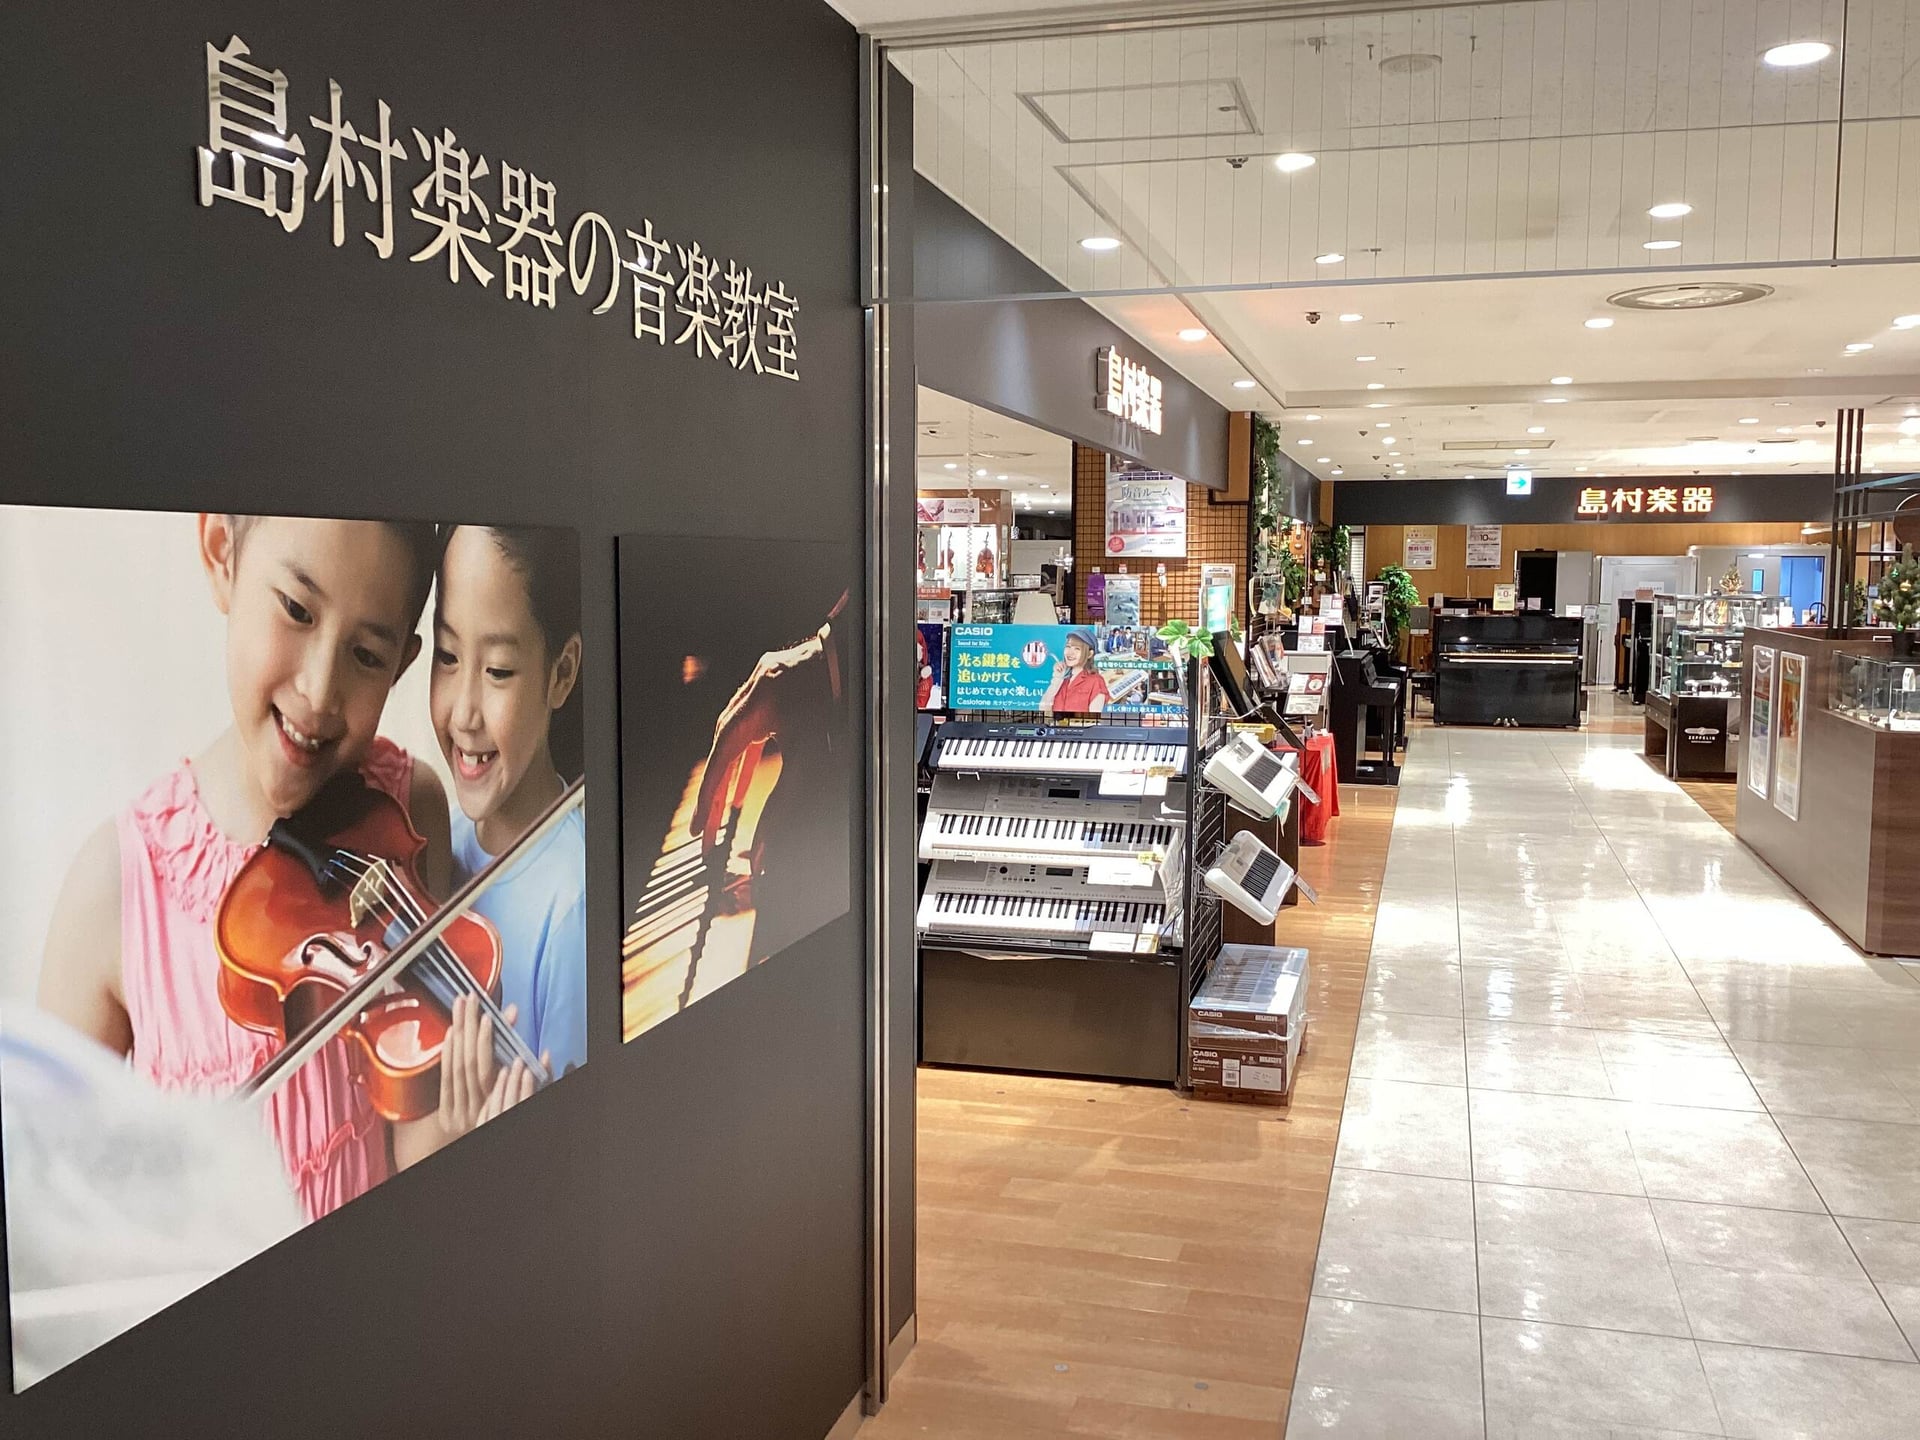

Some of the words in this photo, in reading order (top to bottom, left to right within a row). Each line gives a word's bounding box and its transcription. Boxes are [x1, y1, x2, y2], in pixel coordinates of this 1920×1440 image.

[199, 35, 800, 381] 島村楽器の音楽教室
[1107, 345, 1162, 435] 島村楽器
[1577, 486, 1714, 514] 島村楽器
[955, 627, 993, 636] CASIO
[957, 652, 1020, 668] 光る鍵盤を
[957, 669, 1016, 683] 追いかけて、
[957, 685, 1043, 697] はじめてでもすぐ楽しい！
[957, 698, 991, 706] Casiotone
[1198, 1010, 1222, 1018] CASIO
[1193, 1050, 1218, 1058] CASIO
